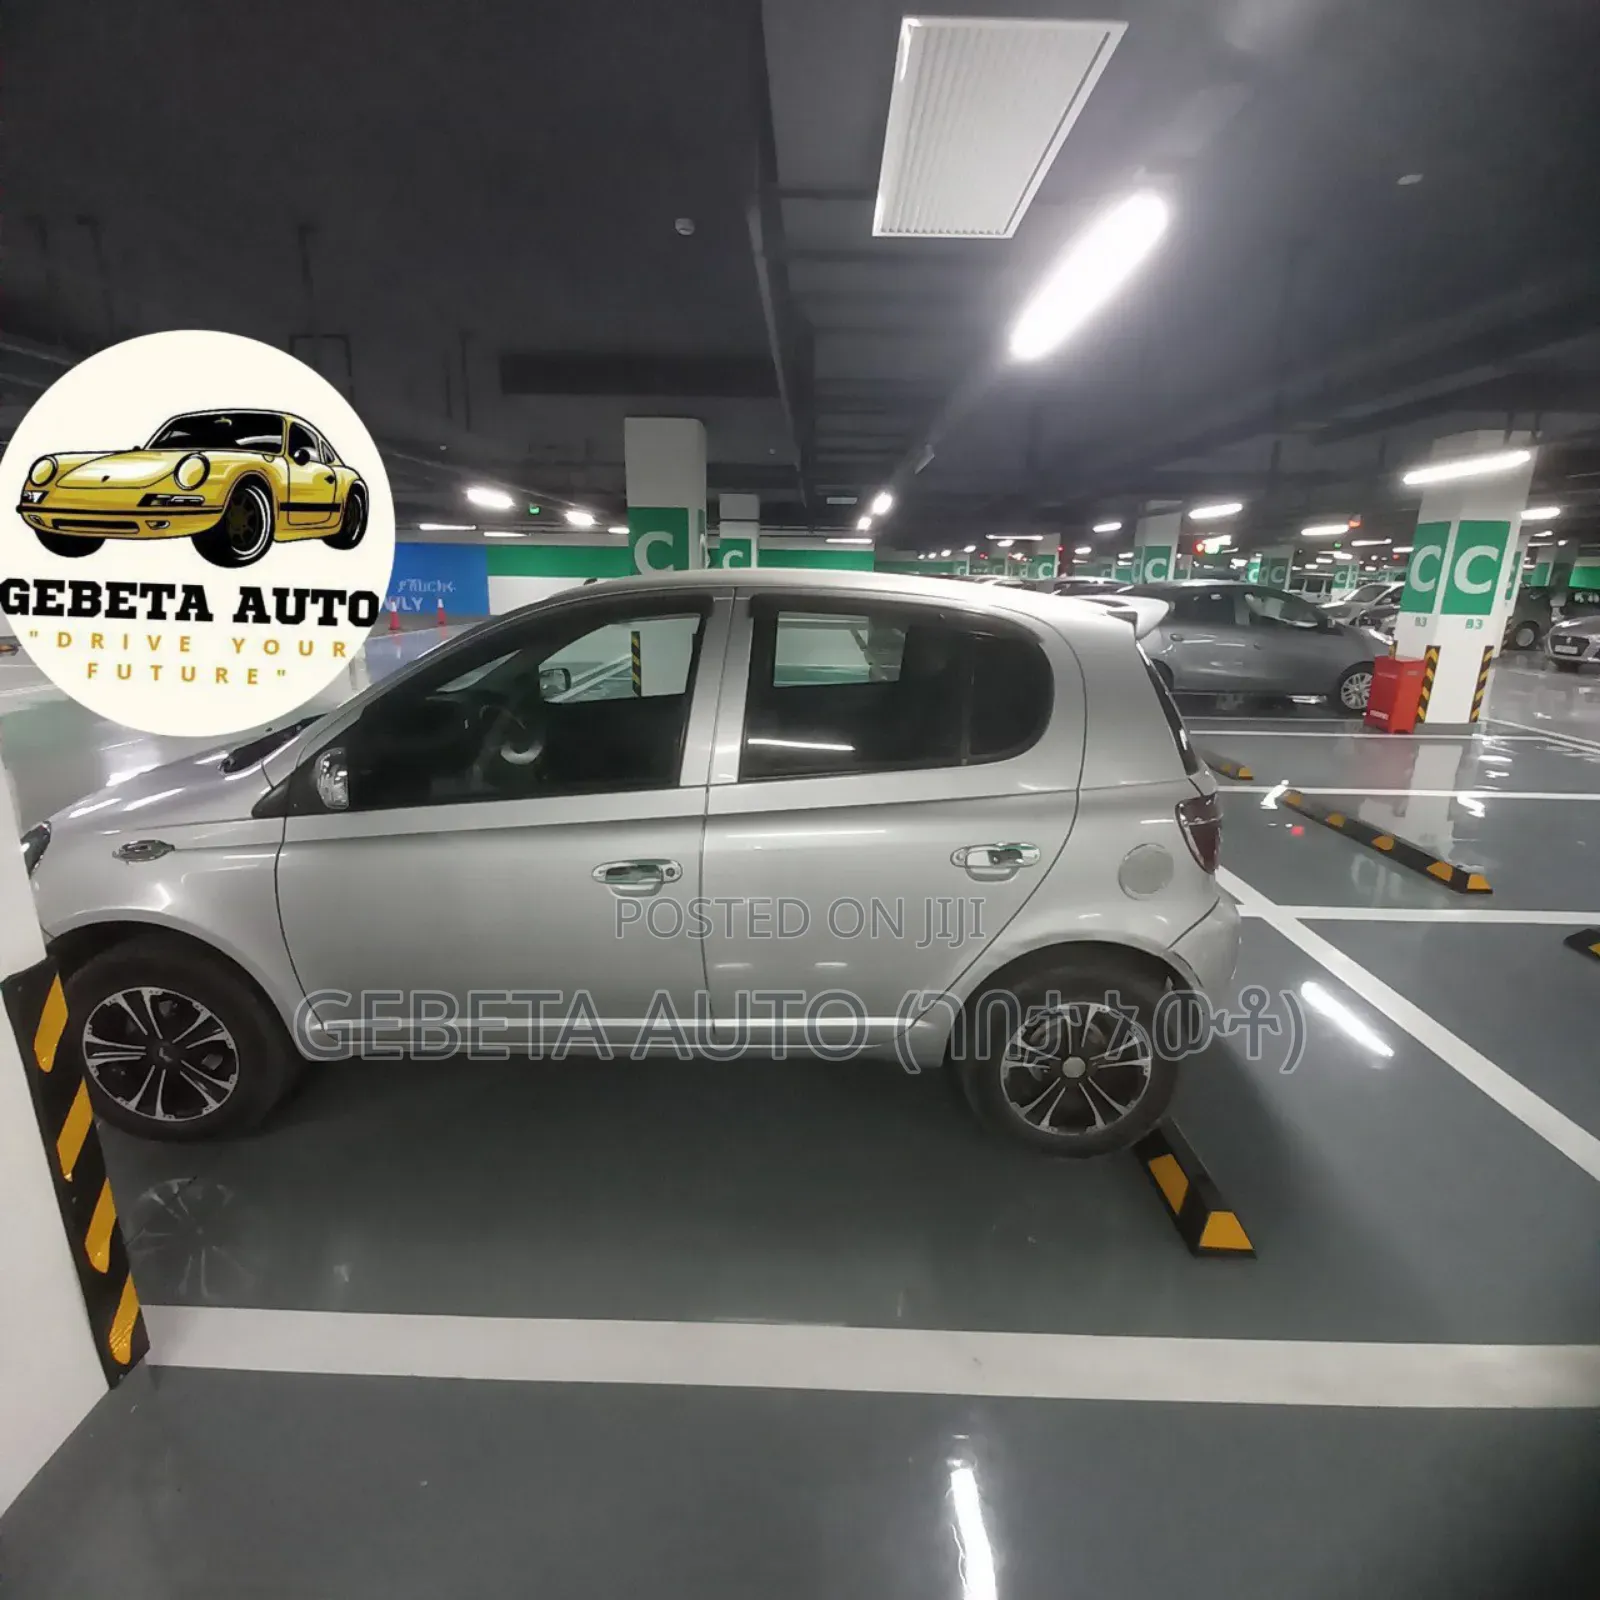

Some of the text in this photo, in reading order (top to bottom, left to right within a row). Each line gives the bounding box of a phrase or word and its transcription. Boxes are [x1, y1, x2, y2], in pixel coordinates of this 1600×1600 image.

[634, 531, 675, 574] C
[1144, 558, 1167, 582] C
[1410, 544, 1442, 593] C
[1453, 544, 1499, 595] C
